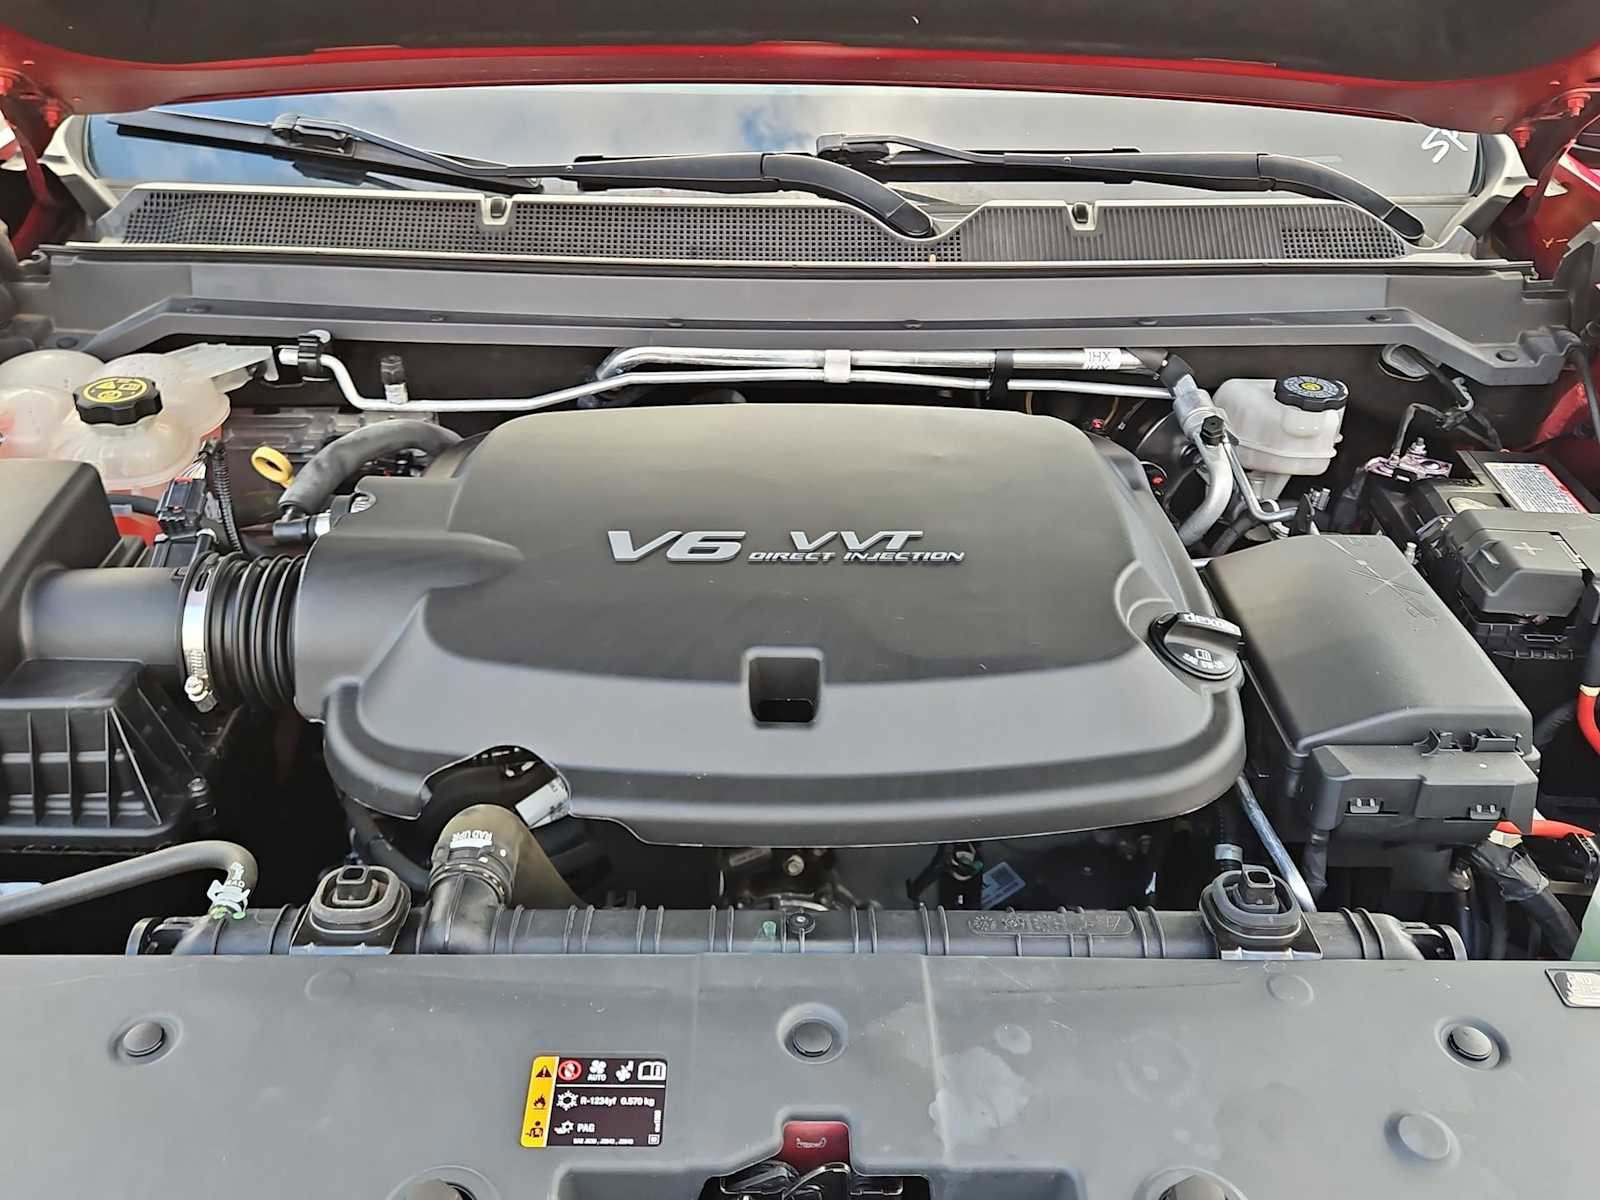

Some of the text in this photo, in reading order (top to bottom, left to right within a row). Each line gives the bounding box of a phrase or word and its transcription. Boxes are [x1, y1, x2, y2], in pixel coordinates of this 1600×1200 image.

[607, 530, 925, 562] V6 VVT
[748, 551, 966, 562] DIRECT INJECTION
[587, 1074, 606, 1082] AUTO
[580, 1096, 655, 1107] R-1234yf 0.570 kg
[577, 1123, 595, 1133] PAG
